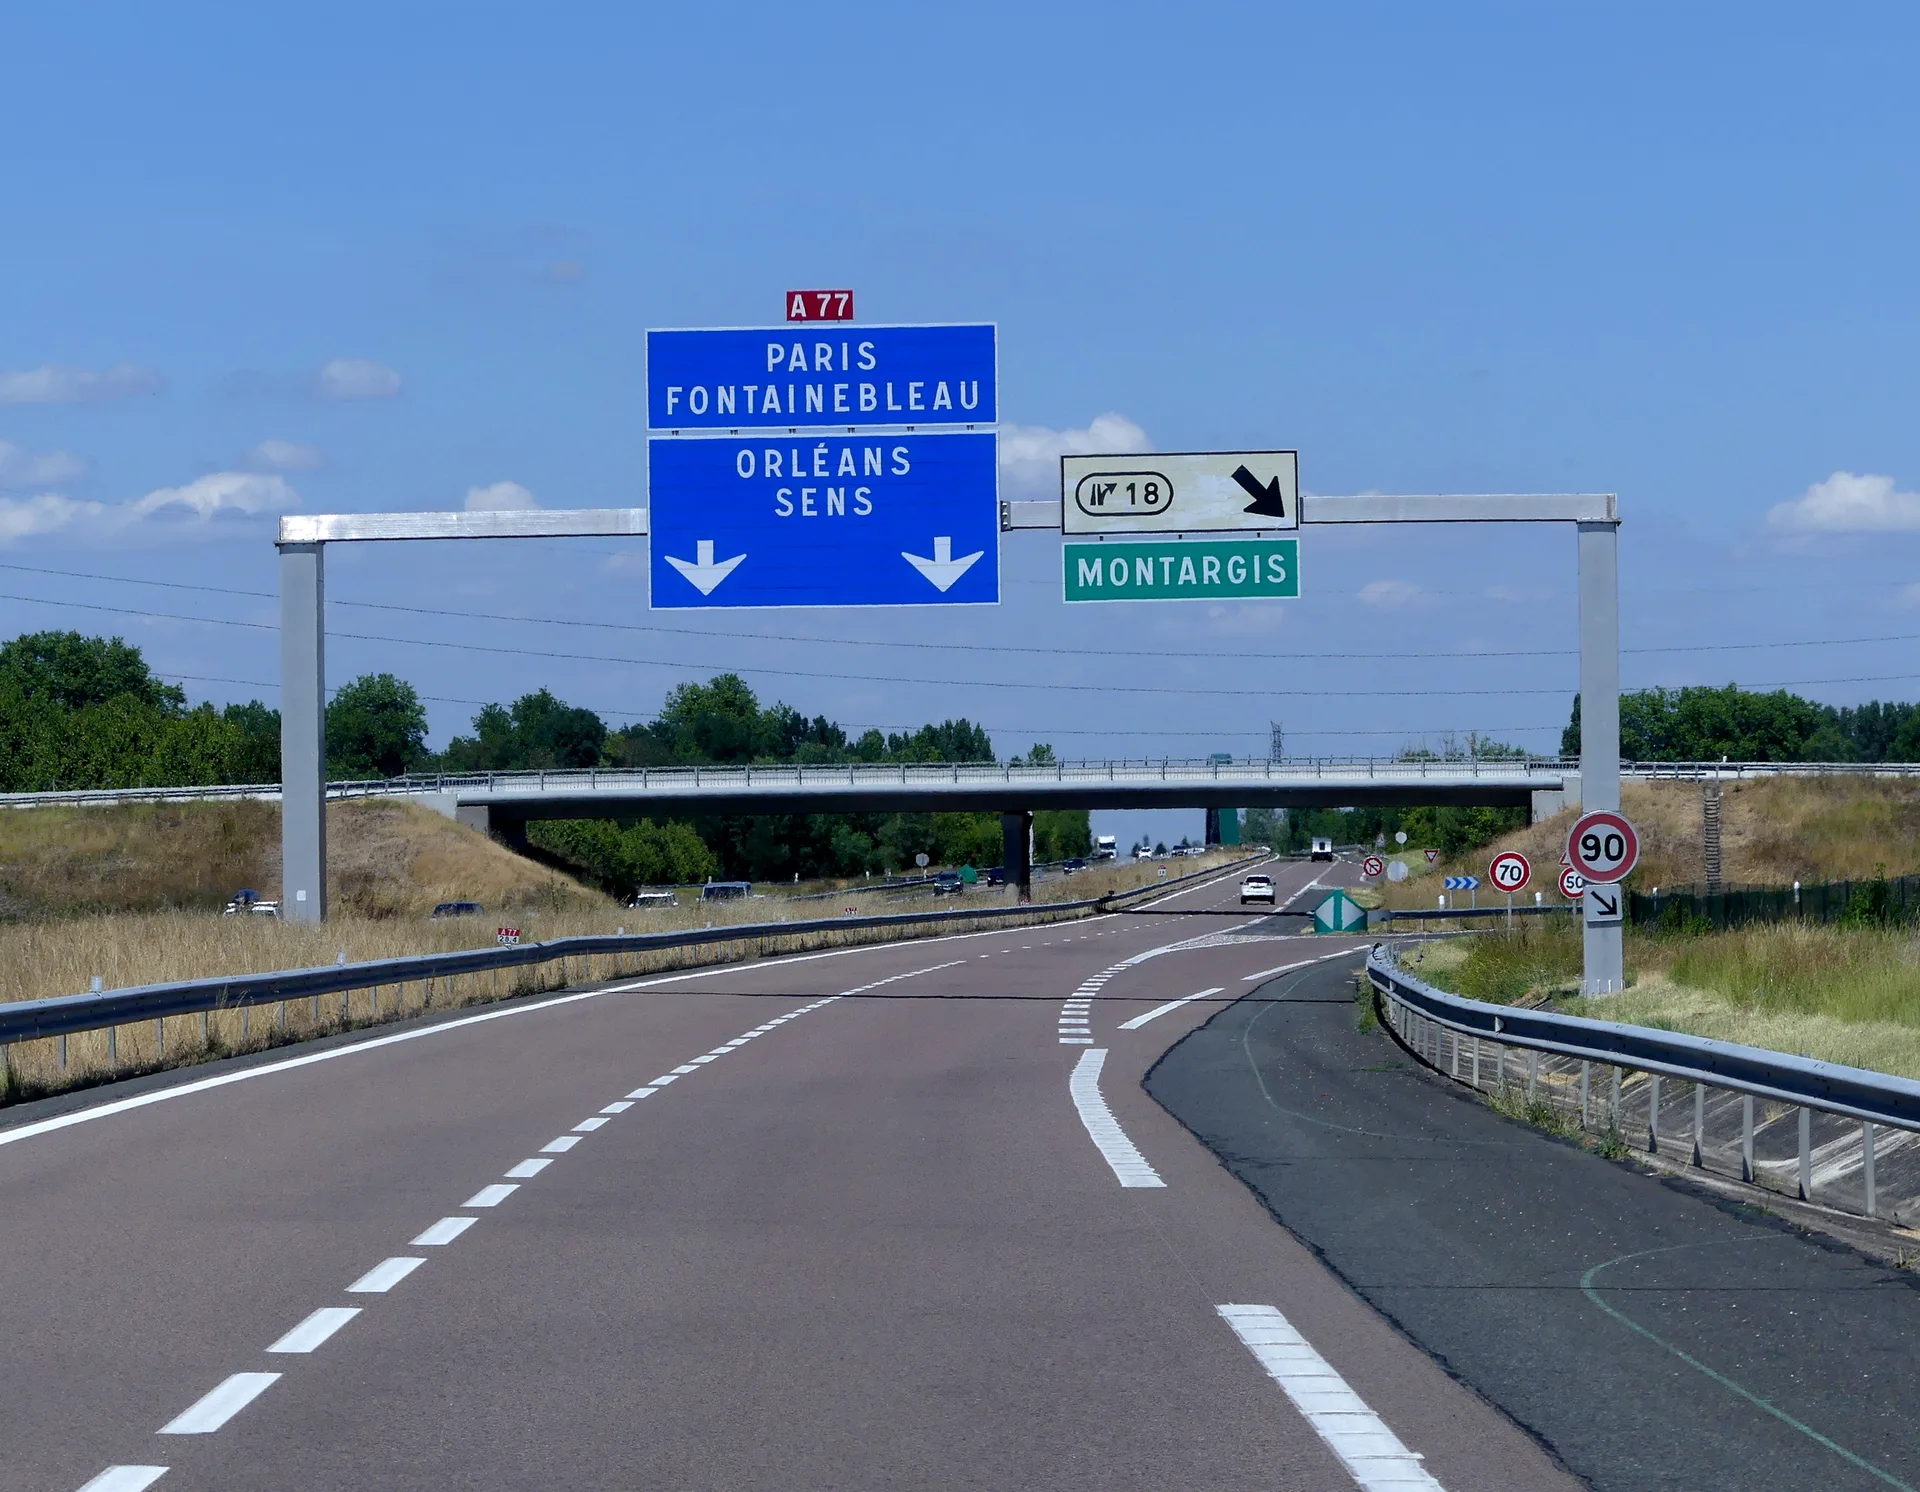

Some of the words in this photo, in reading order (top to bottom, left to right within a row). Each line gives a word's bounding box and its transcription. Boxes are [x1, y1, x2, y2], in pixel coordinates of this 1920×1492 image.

[791, 294, 806, 317] A
[817, 293, 849, 317] 77
[766, 341, 876, 372] PARIS
[666, 380, 979, 415] FONTAINEBLEAU
[736, 443, 911, 479] ORLÉANS
[774, 487, 873, 517] SENS
[1126, 482, 1159, 505] 18
[1078, 554, 1286, 587] MONTARGIS
[1581, 834, 1624, 862] 90
[1499, 864, 1522, 881] 70
